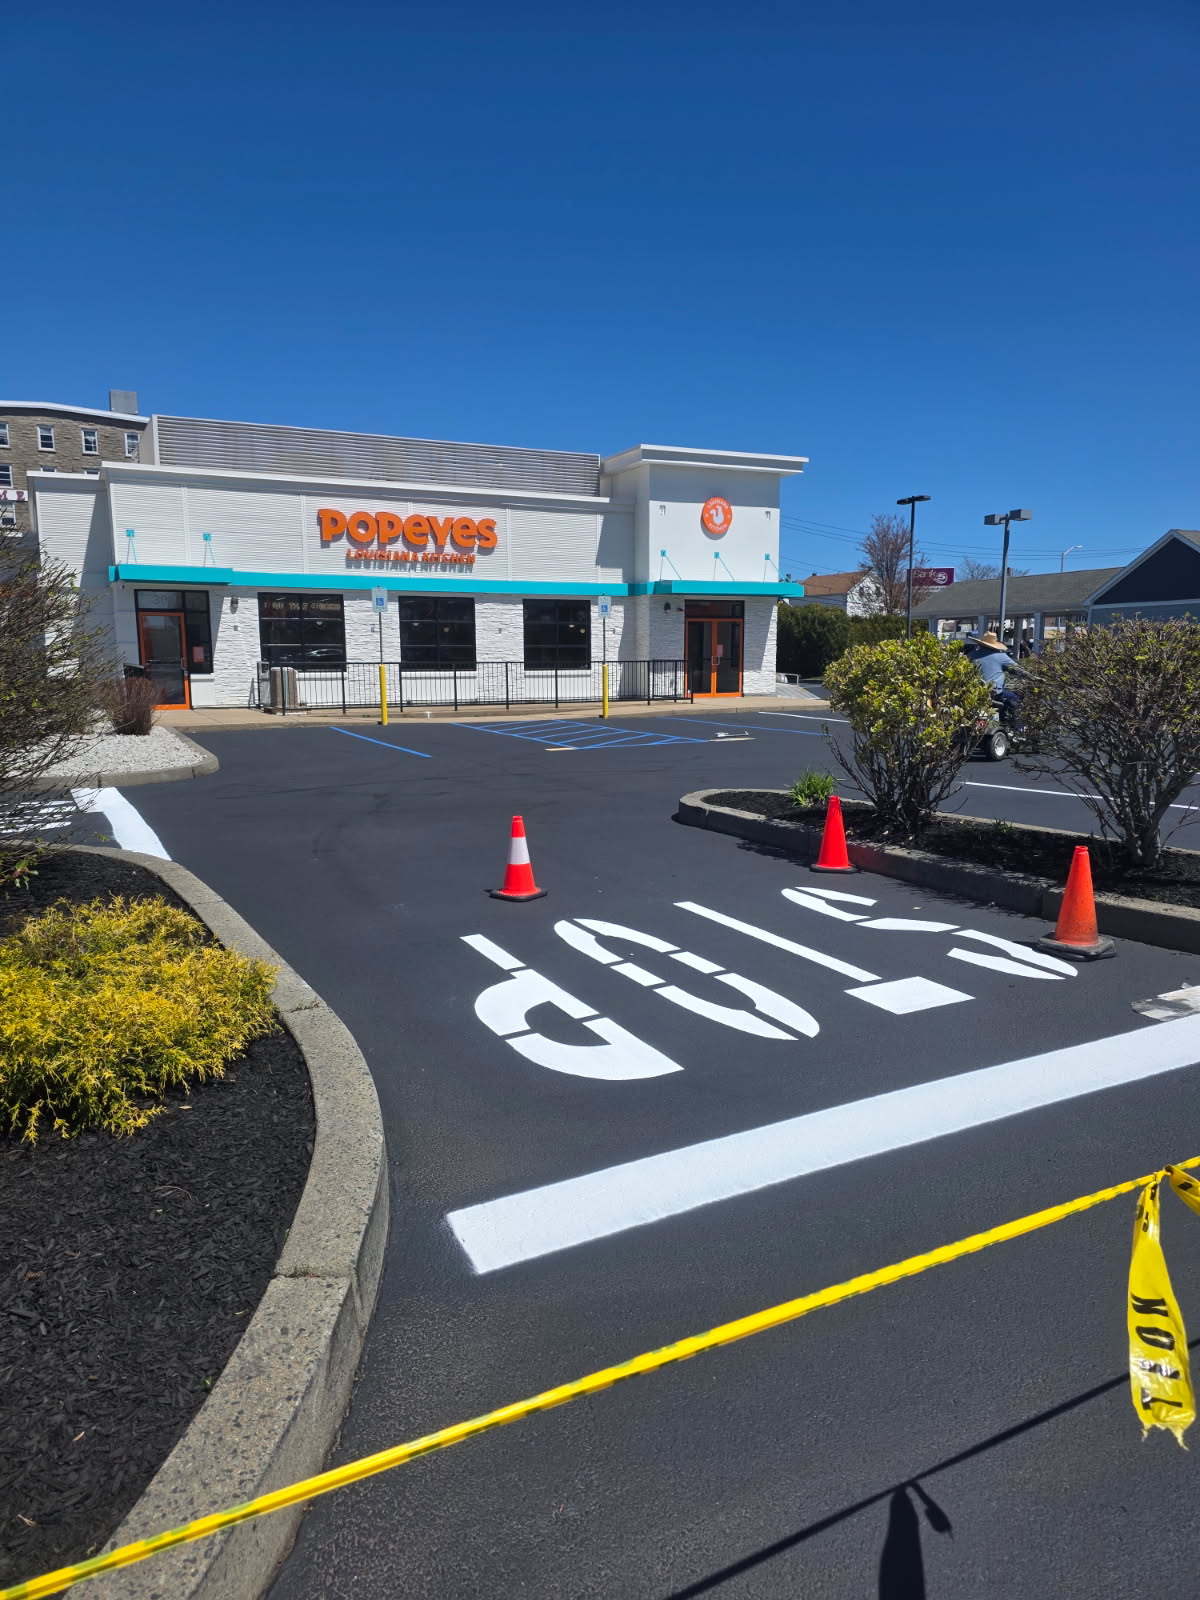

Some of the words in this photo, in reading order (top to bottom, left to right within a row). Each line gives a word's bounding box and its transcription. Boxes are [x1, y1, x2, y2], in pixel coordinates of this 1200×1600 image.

[346, 549, 419, 562] LOUISIANA
[421, 552, 476, 564] KITCHEN
[460, 886, 1079, 1081] STOP
